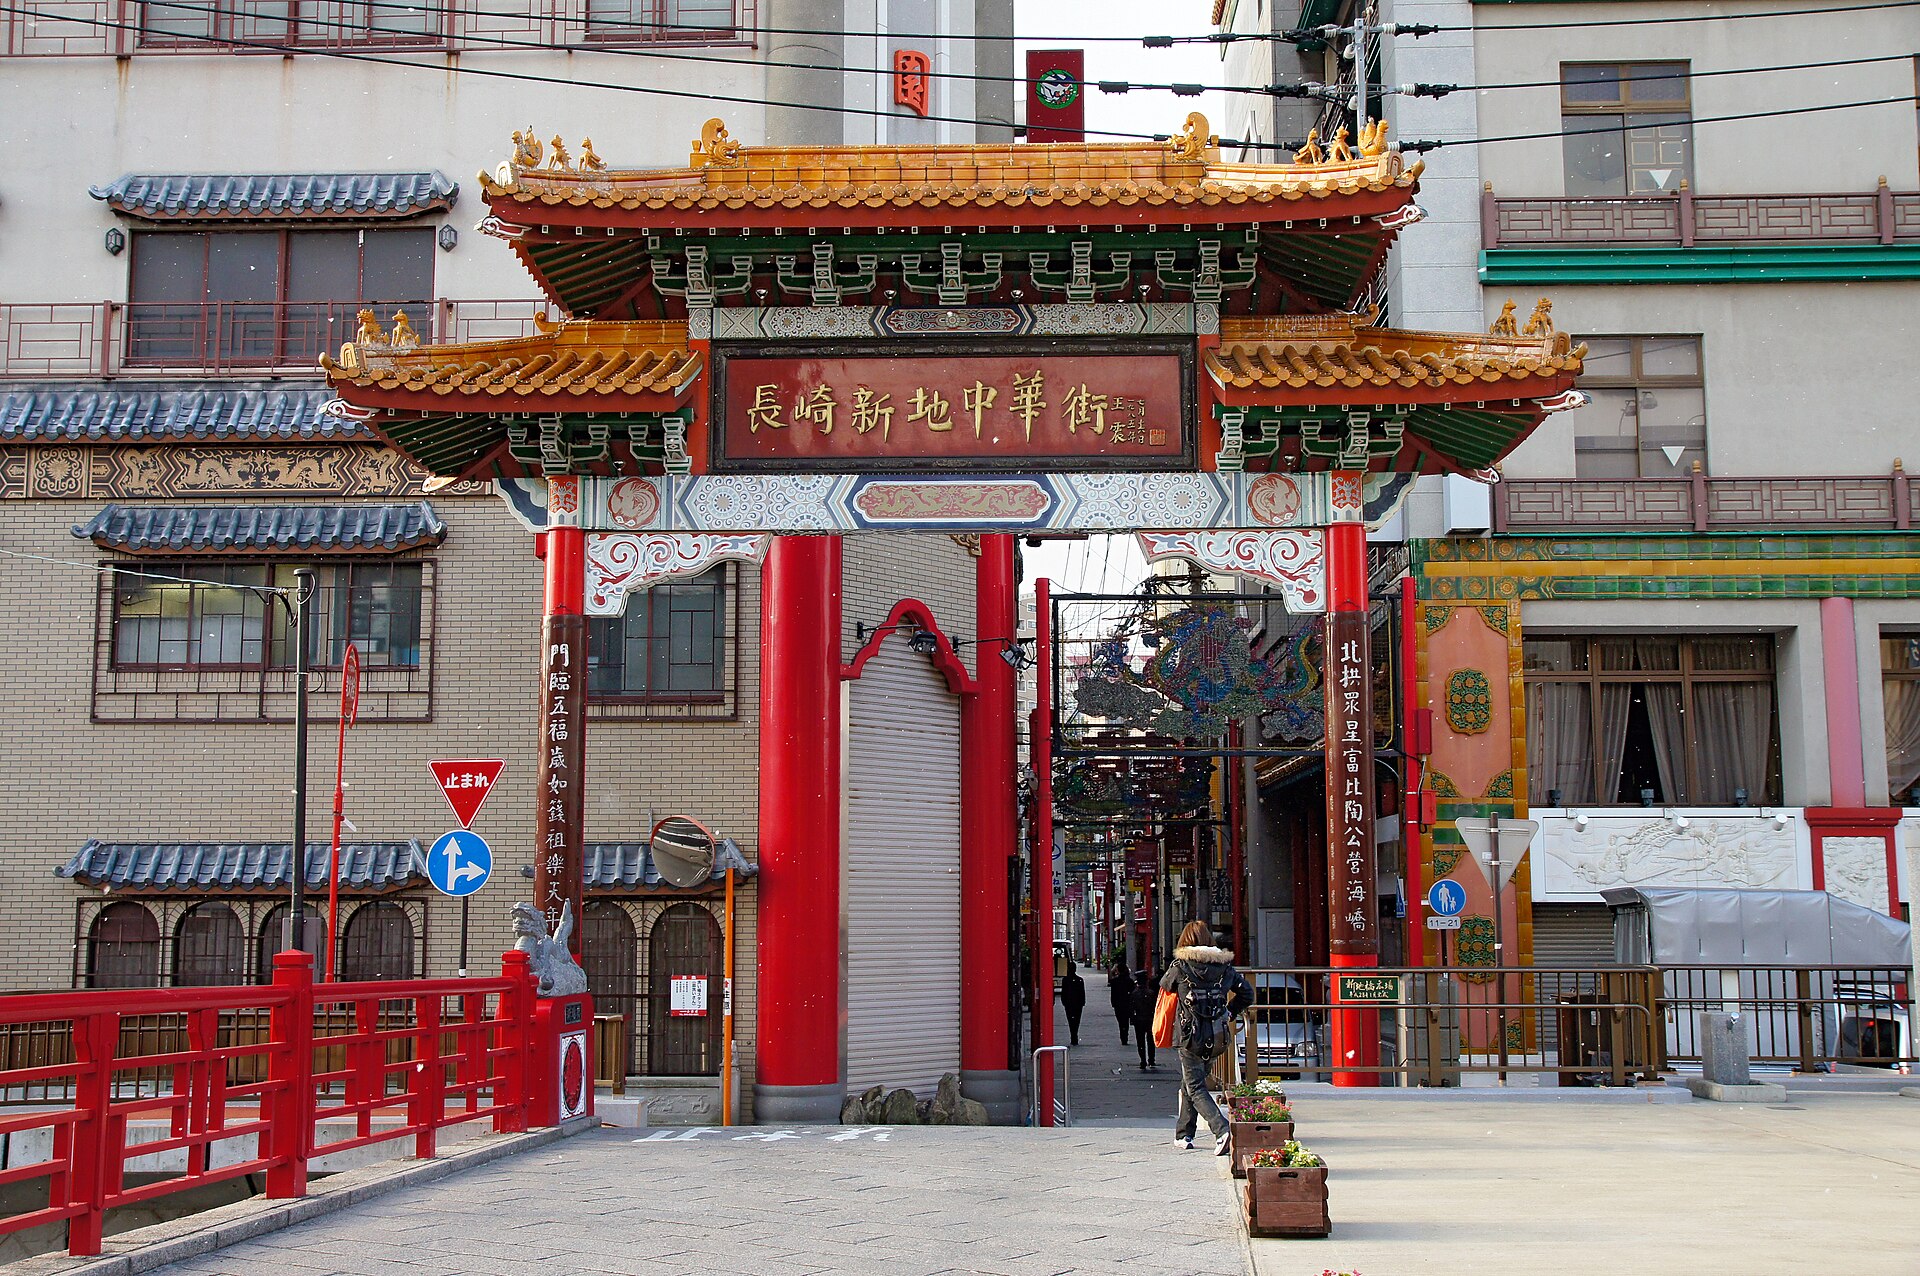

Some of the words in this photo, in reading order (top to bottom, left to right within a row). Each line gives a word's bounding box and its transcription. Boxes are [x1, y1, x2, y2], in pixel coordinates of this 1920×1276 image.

[746, 369, 1108, 443] 長崎新地中華街
[444, 772, 490, 789] 止まれ
[632, 1127, 894, 1142] 止まれ
